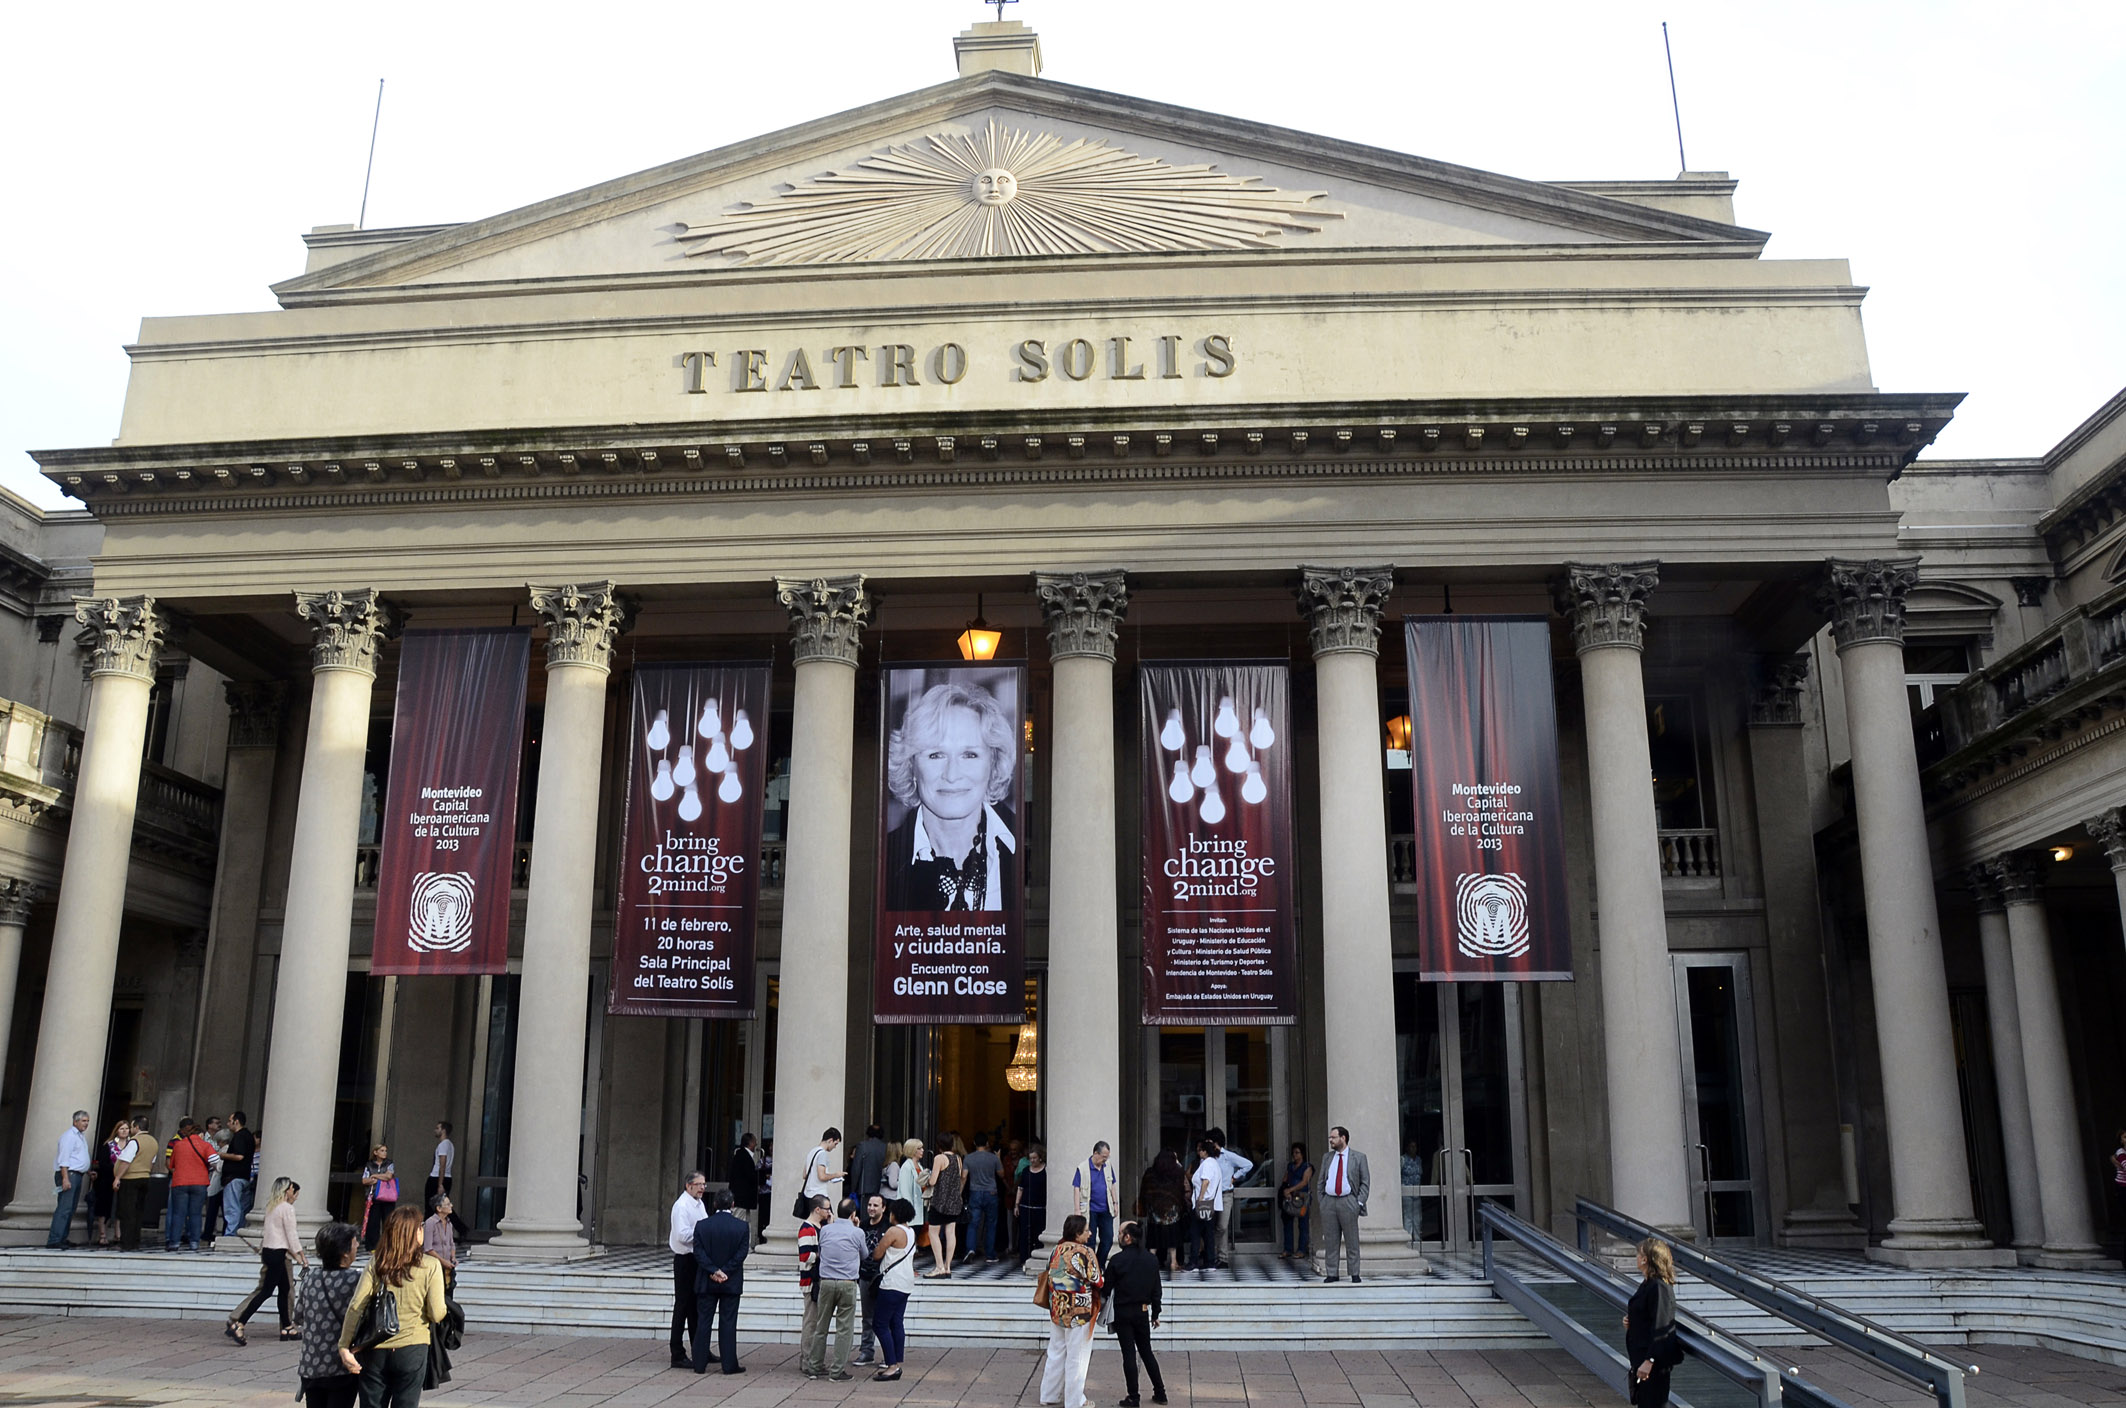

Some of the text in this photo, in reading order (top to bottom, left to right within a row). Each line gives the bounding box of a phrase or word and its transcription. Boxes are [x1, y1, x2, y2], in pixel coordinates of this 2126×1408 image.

[681, 334, 1238, 394] TEATRO SOLIS
[421, 786, 482, 799] Montevideo
[1452, 782, 1521, 795] Montevideo
[433, 799, 468, 813] Capital
[1467, 796, 1507, 810] Capital
[410, 812, 489, 824] Iberoamericana
[1443, 810, 1533, 822] Iberoamericana
[415, 825, 479, 837] de la Cultura
[1451, 823, 1524, 835] de la Cultura
[436, 840, 458, 851] 2013
[666, 830, 720, 855] bring
[1188, 832, 1247, 858] bring
[1477, 839, 1503, 850] 2013
[640, 844, 744, 883] change
[1164, 848, 1274, 887] change
[648, 875, 726, 896] 2mind.org
[1174, 879, 1257, 902] 2mind.org
[644, 917, 732, 932] 11 de febrero,
[895, 924, 1006, 936] Arte, salud mental
[657, 937, 714, 950] 20 horas
[894, 938, 1006, 958] y ciudadanía.
[640, 955, 730, 973] Sala Principal
[911, 964, 989, 974] Encuentro con
[634, 975, 734, 989] del Teatro Solís
[894, 976, 1007, 995] Glenn Close
